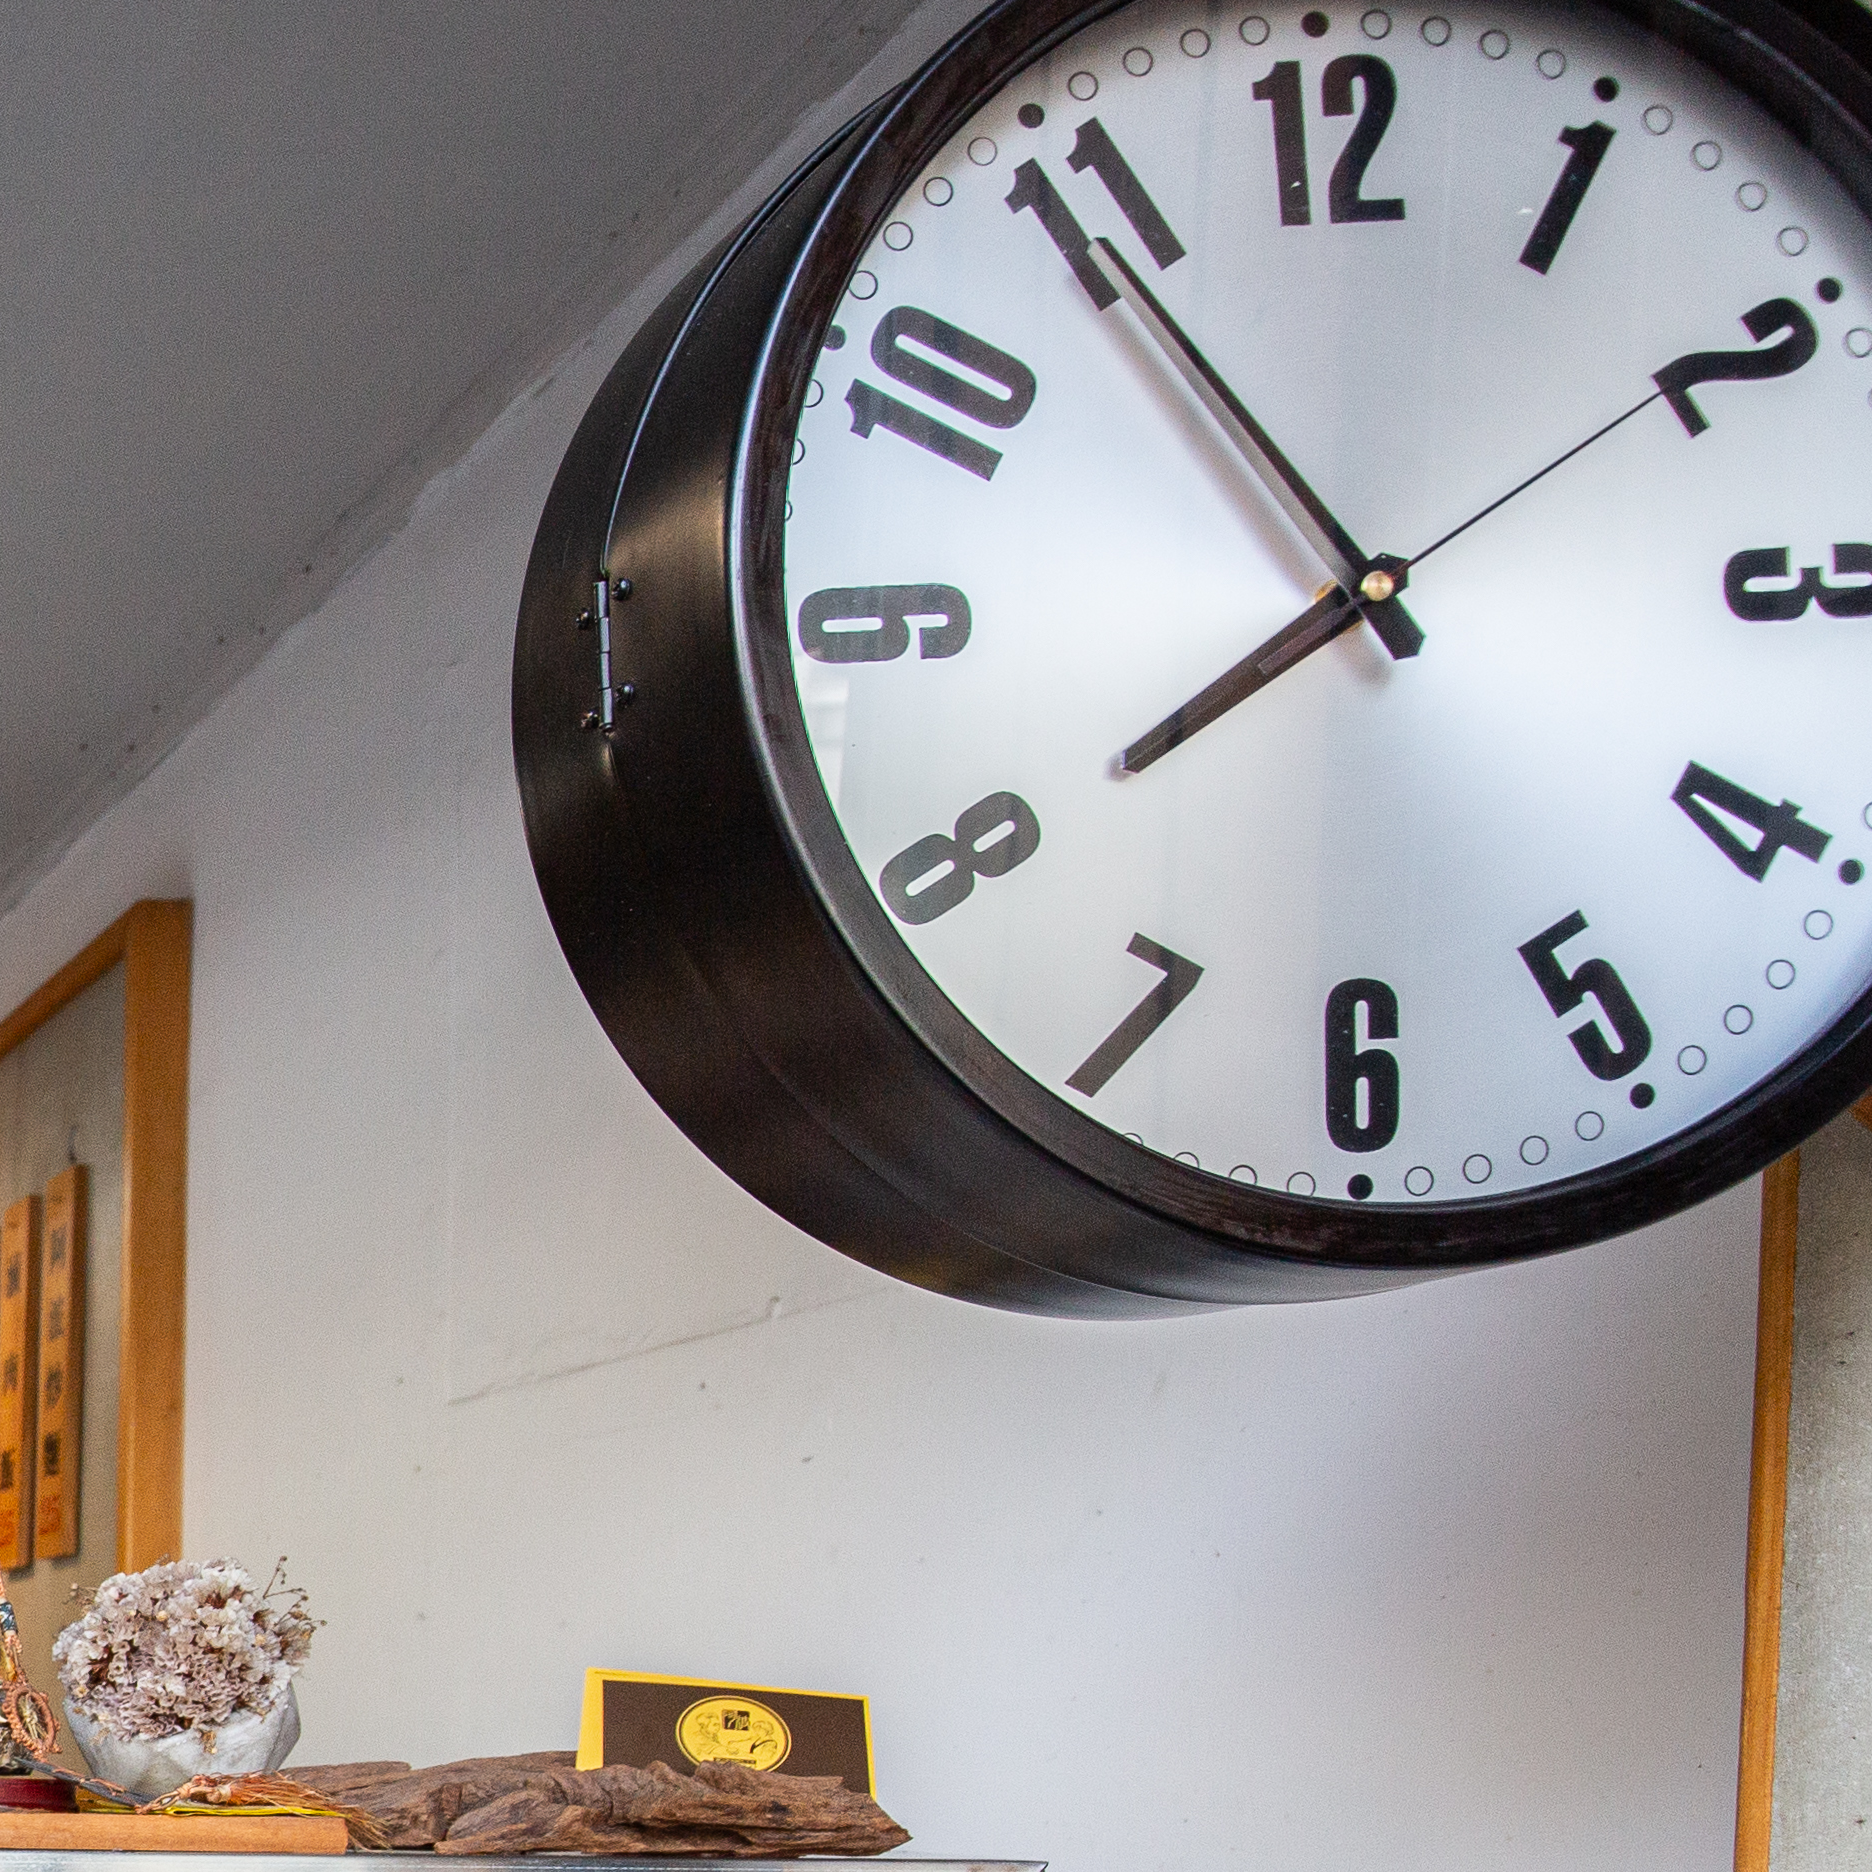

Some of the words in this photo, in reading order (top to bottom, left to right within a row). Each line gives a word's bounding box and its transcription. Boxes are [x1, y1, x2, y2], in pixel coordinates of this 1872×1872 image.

[1005, 117, 1187, 311] 11
[1252, 53, 1407, 227] 12
[1519, 121, 1616, 276] 1
[845, 306, 1037, 482] 10
[1652, 297, 1819, 438] 2
[797, 582, 973, 664] 9
[1722, 543, 1872, 622] 3
[878, 790, 1042, 926] 8
[1670, 760, 1832, 883] 4
[1065, 932, 1204, 1098] 7
[1324, 977, 1400, 1154] 6
[1517, 910, 1653, 1082] 5
